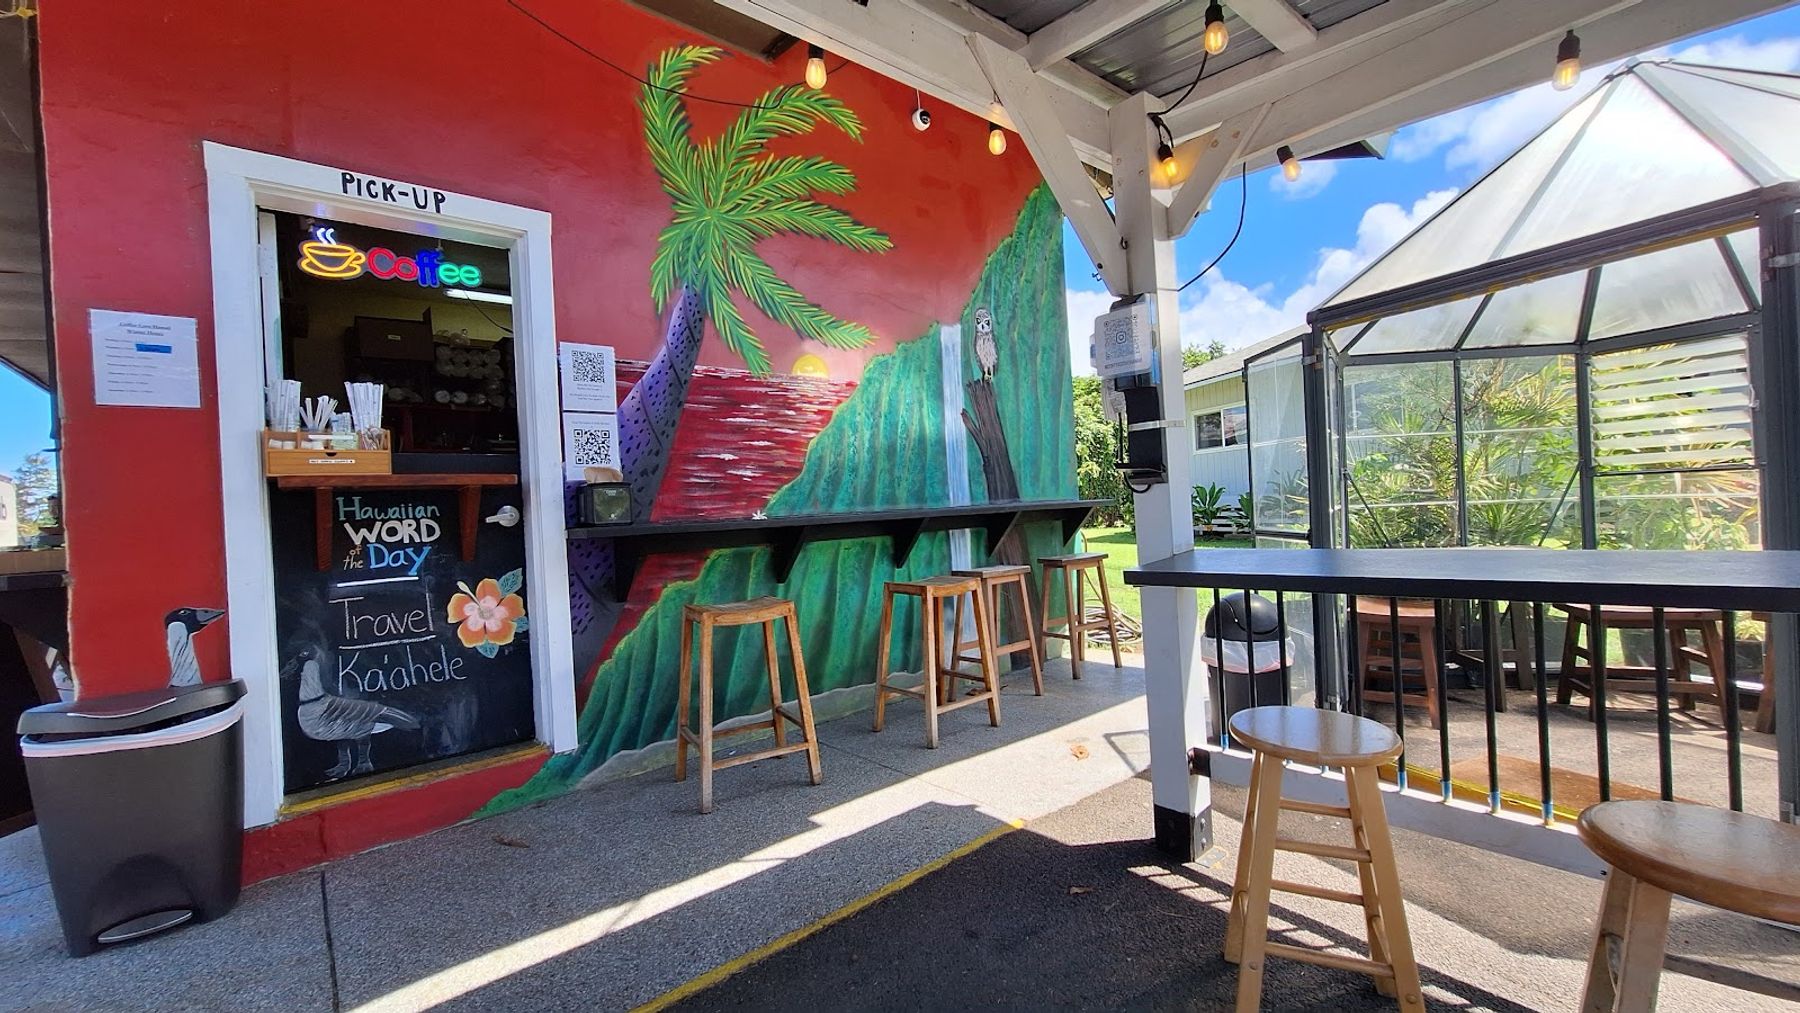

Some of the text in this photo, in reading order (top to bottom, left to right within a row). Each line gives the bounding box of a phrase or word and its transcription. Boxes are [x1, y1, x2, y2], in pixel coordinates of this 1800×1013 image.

[341, 172, 446, 214] PICK-UP
[367, 247, 481, 286] Coffee
[336, 496, 440, 521] Hawaiian
[344, 518, 441, 545] WORD
[343, 543, 432, 576] the Day
[349, 544, 362, 556] of
[328, 592, 434, 640] Travel
